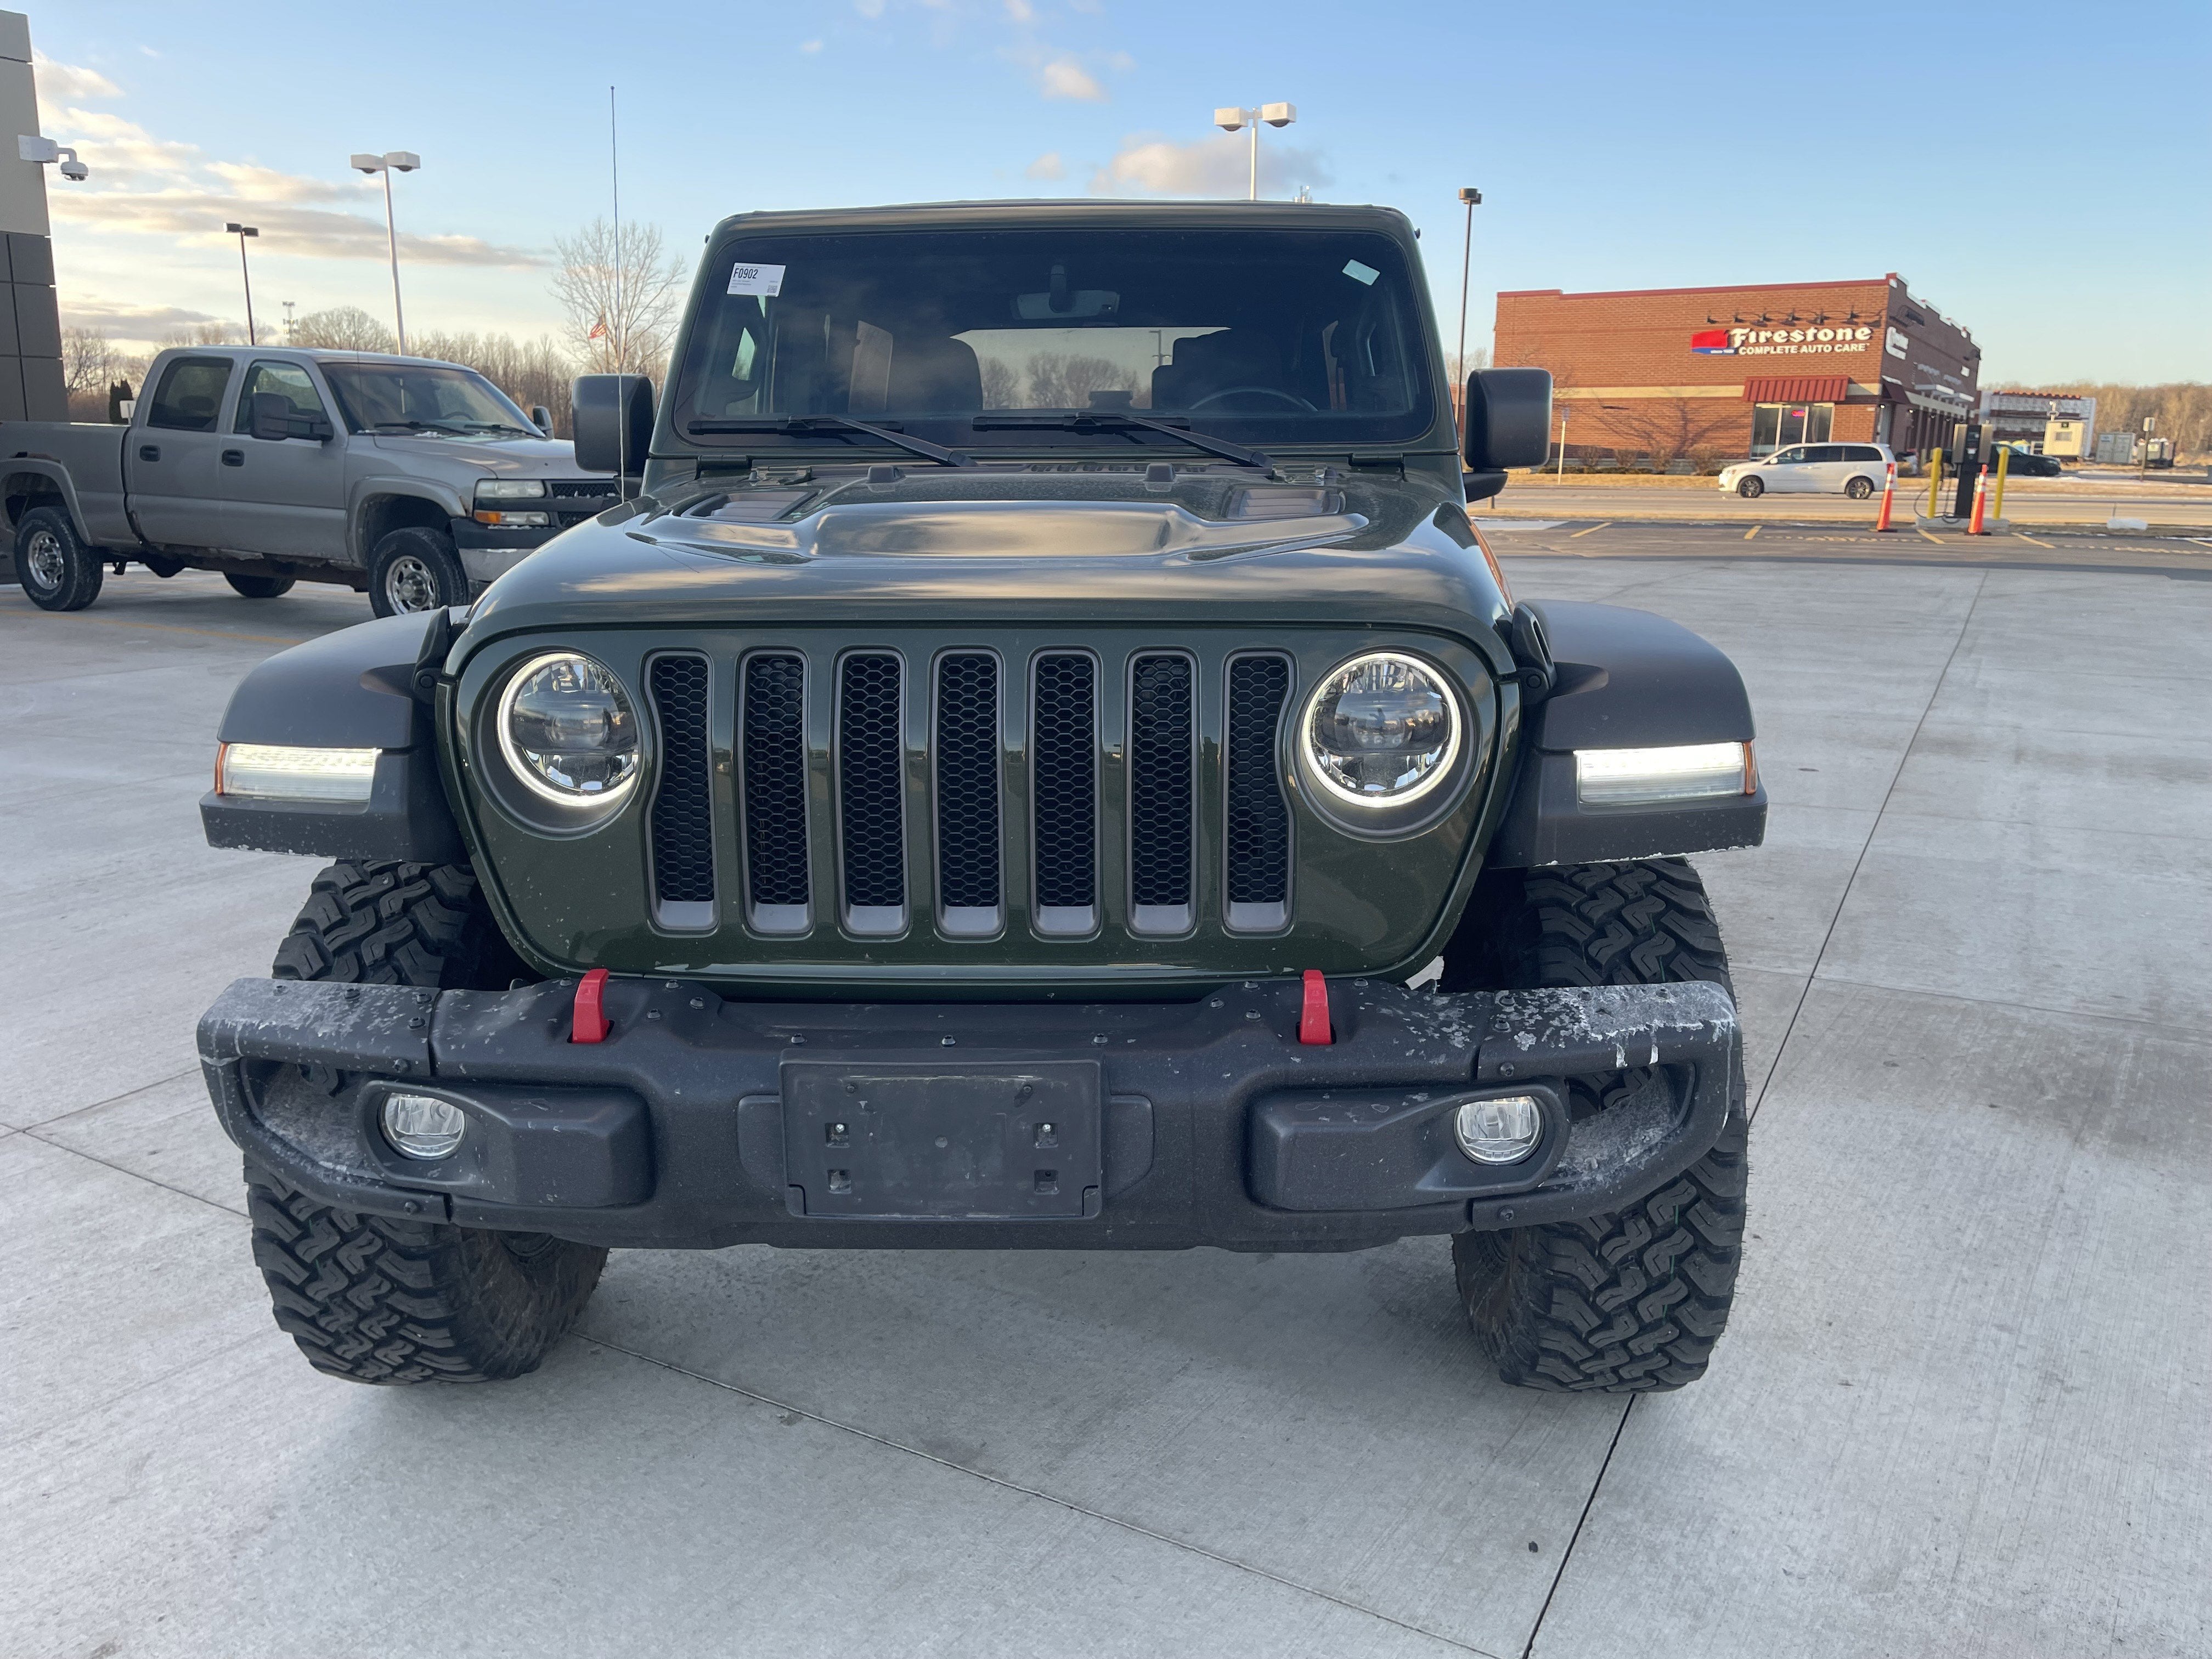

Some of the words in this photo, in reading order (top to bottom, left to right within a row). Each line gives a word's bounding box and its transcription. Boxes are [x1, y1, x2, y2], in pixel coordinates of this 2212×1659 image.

[733, 268, 758, 279] F0902
[1730, 327, 1872, 348] Firestone
[1738, 345, 1798, 355] COMPLETE
[1799, 344, 1832, 353] AUTO
[1834, 343, 1866, 352] CARE
